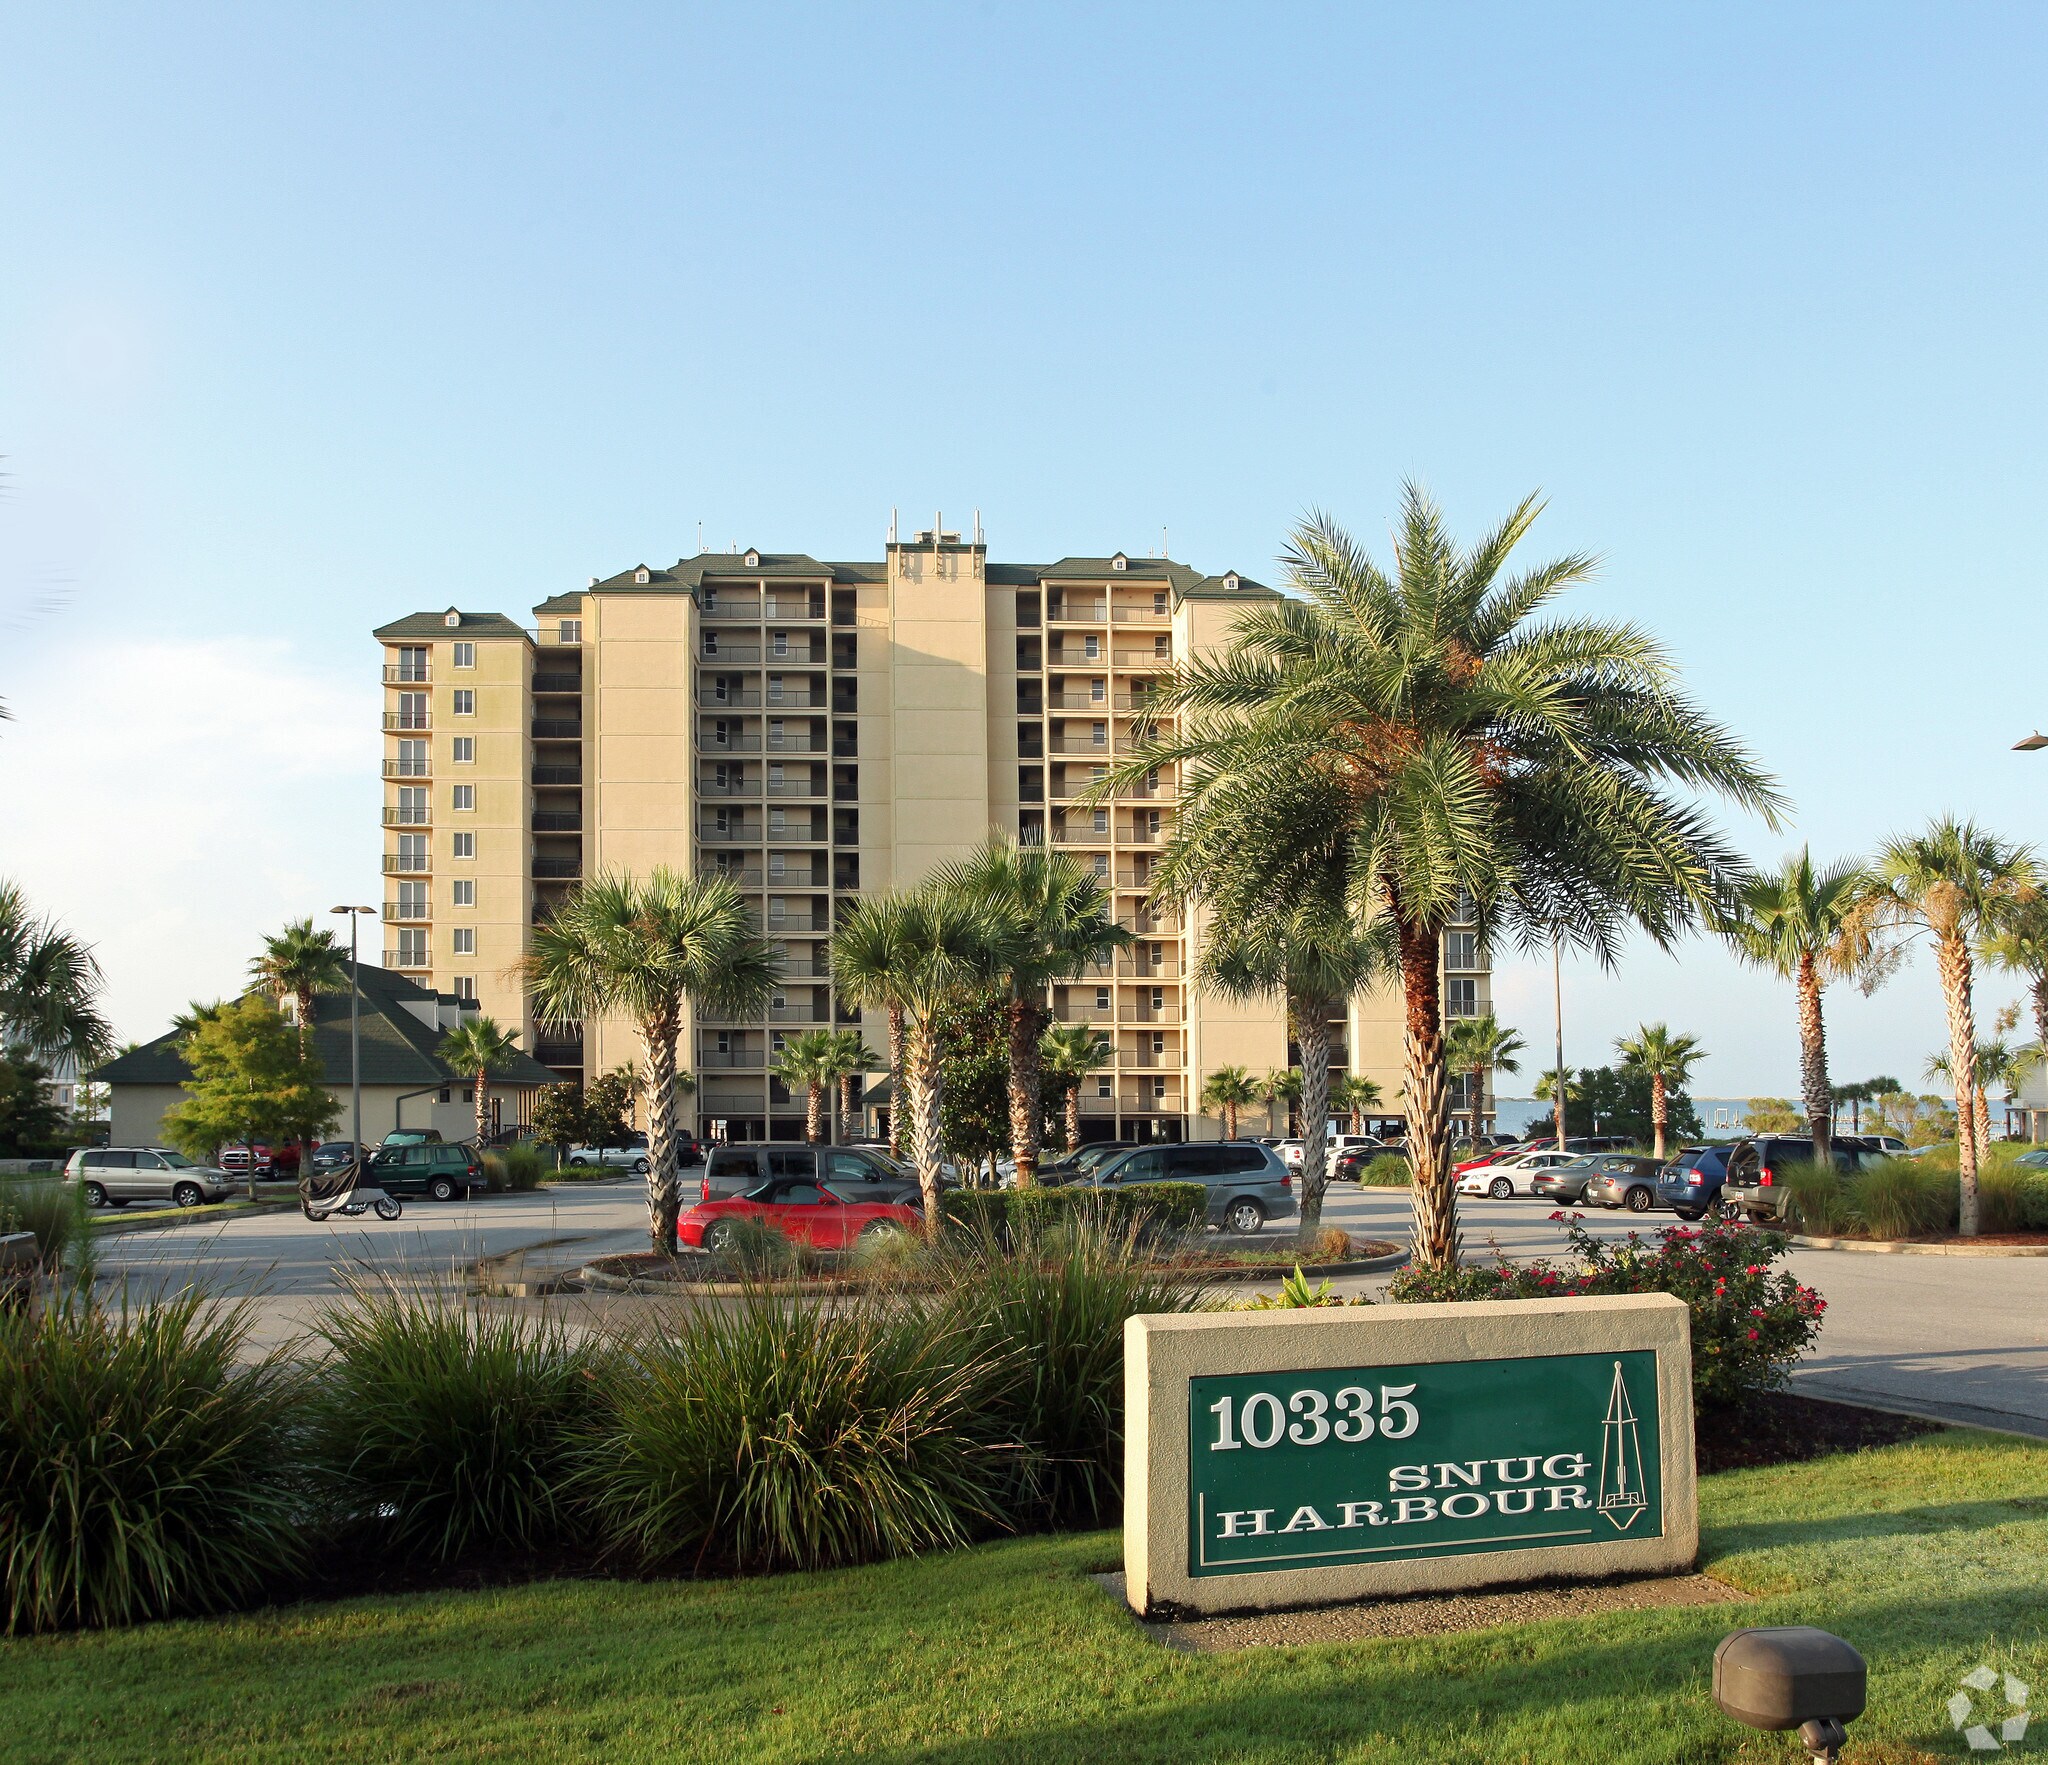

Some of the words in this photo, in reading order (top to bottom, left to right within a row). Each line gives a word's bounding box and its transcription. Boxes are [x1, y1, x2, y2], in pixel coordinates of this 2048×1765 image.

[1210, 1383, 1420, 1451] 10335
[1388, 1452, 1592, 1493] SNUG
[1216, 1484, 1593, 1539] HARBOUR
